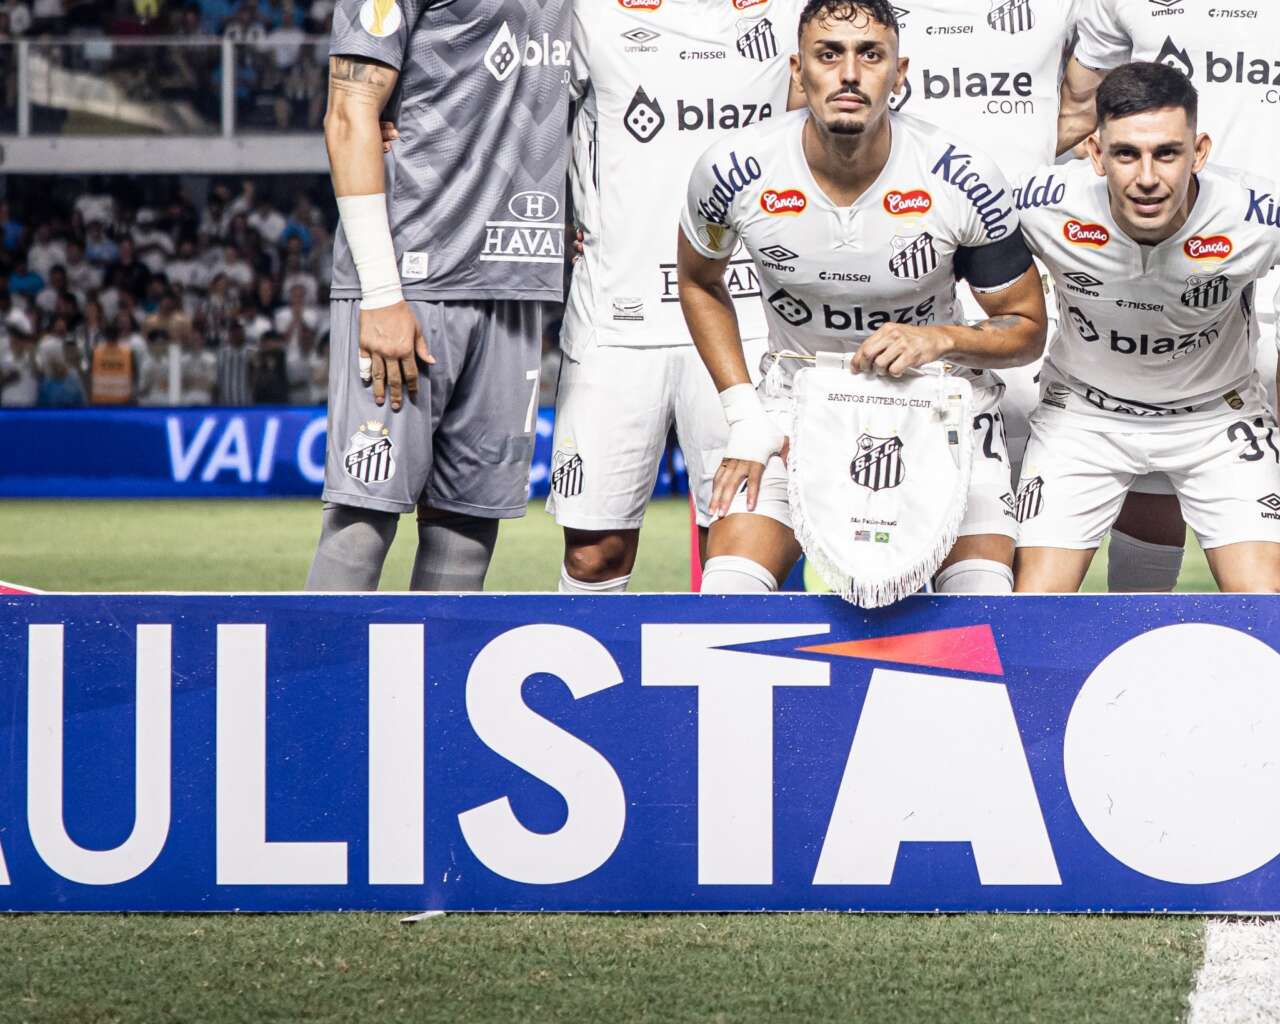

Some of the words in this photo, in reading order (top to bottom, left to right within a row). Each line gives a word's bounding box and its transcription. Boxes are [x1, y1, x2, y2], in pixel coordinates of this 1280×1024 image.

[1151, 7, 1185, 17] umbro
[522, 33, 570, 67] blaz
[922, 67, 1033, 100] blaze
[677, 98, 772, 131] blaze
[982, 99, 1034, 115] .com
[524, 195, 545, 217] H
[931, 143, 1009, 241] Kicaldo
[1012, 174, 1066, 211] aldo
[761, 260, 795, 272] umbro
[1066, 283, 1100, 297] umbro
[1110, 323, 1214, 355] blaz
[827, 393, 864, 403] SANTOS
[866, 395, 908, 407] FUTEBOL
[167, 416, 280, 483] VAI
[973, 411, 1005, 462] 2
